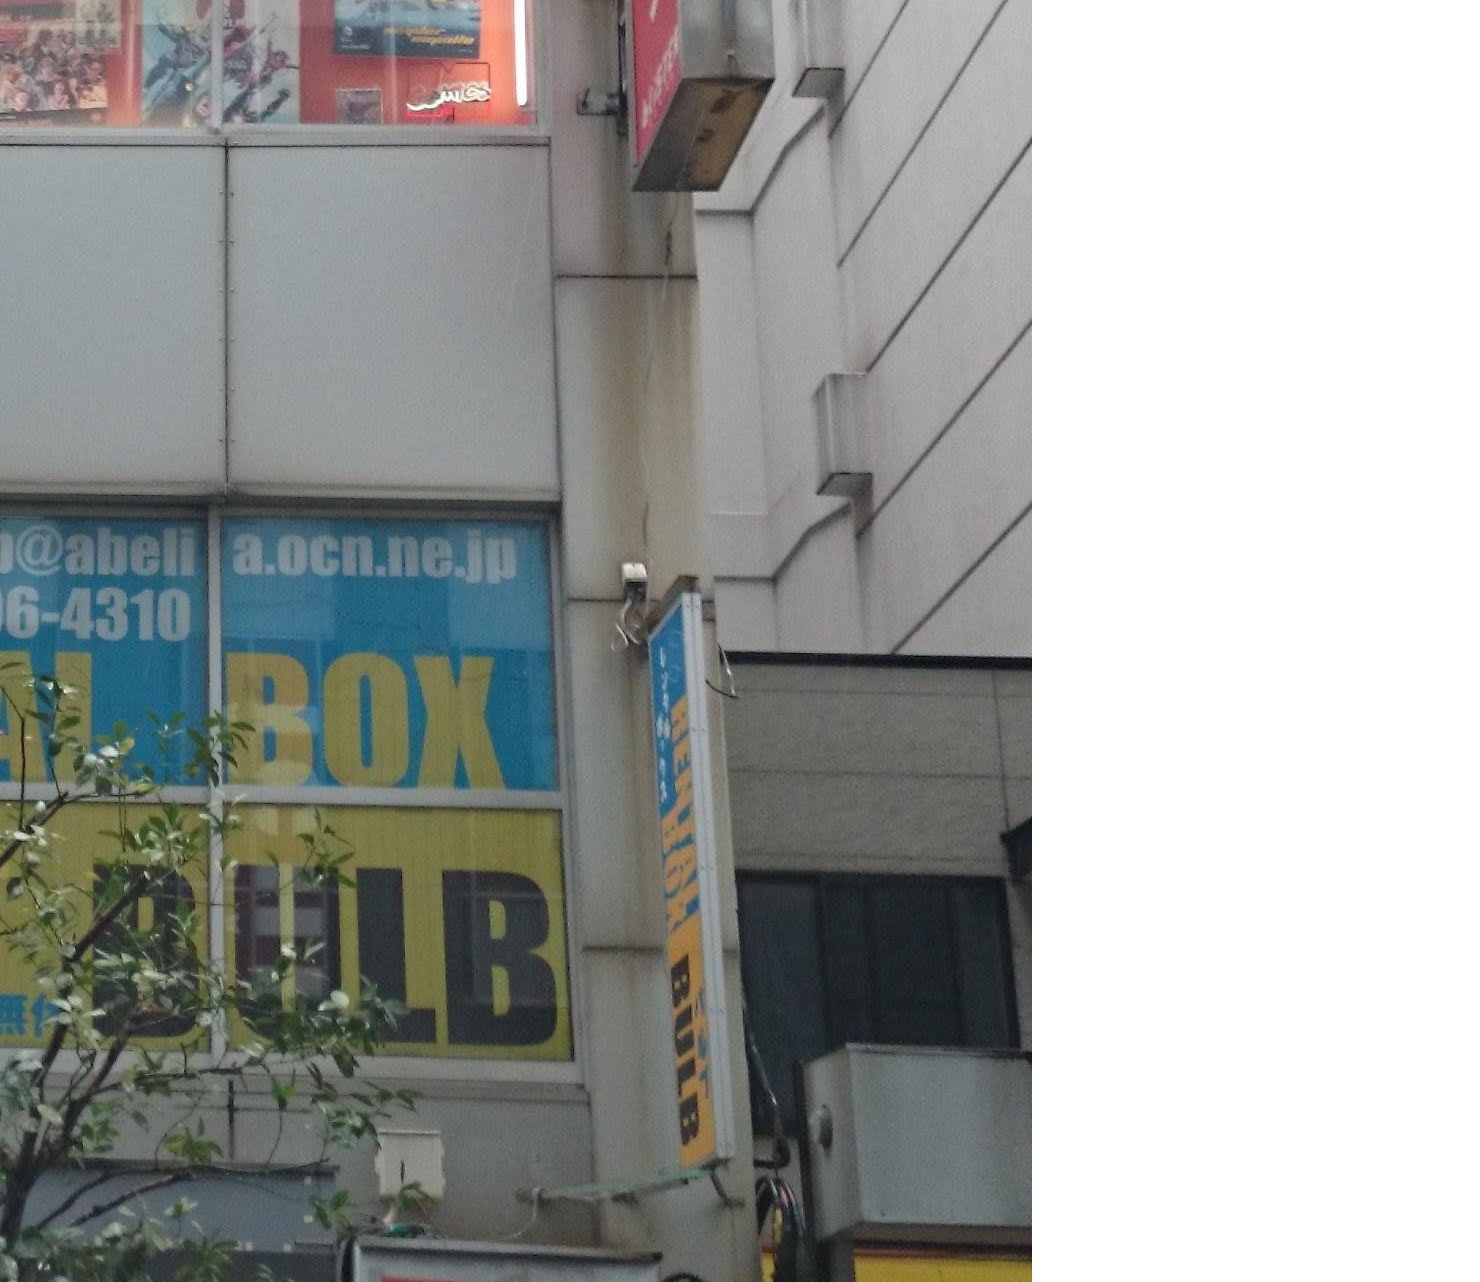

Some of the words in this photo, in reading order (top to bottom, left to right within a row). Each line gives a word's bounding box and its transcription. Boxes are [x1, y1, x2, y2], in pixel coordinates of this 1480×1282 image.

[226, 652, 507, 790] BOX
[92, 864, 559, 1047] BULB
[670, 953, 701, 1147] BULB
